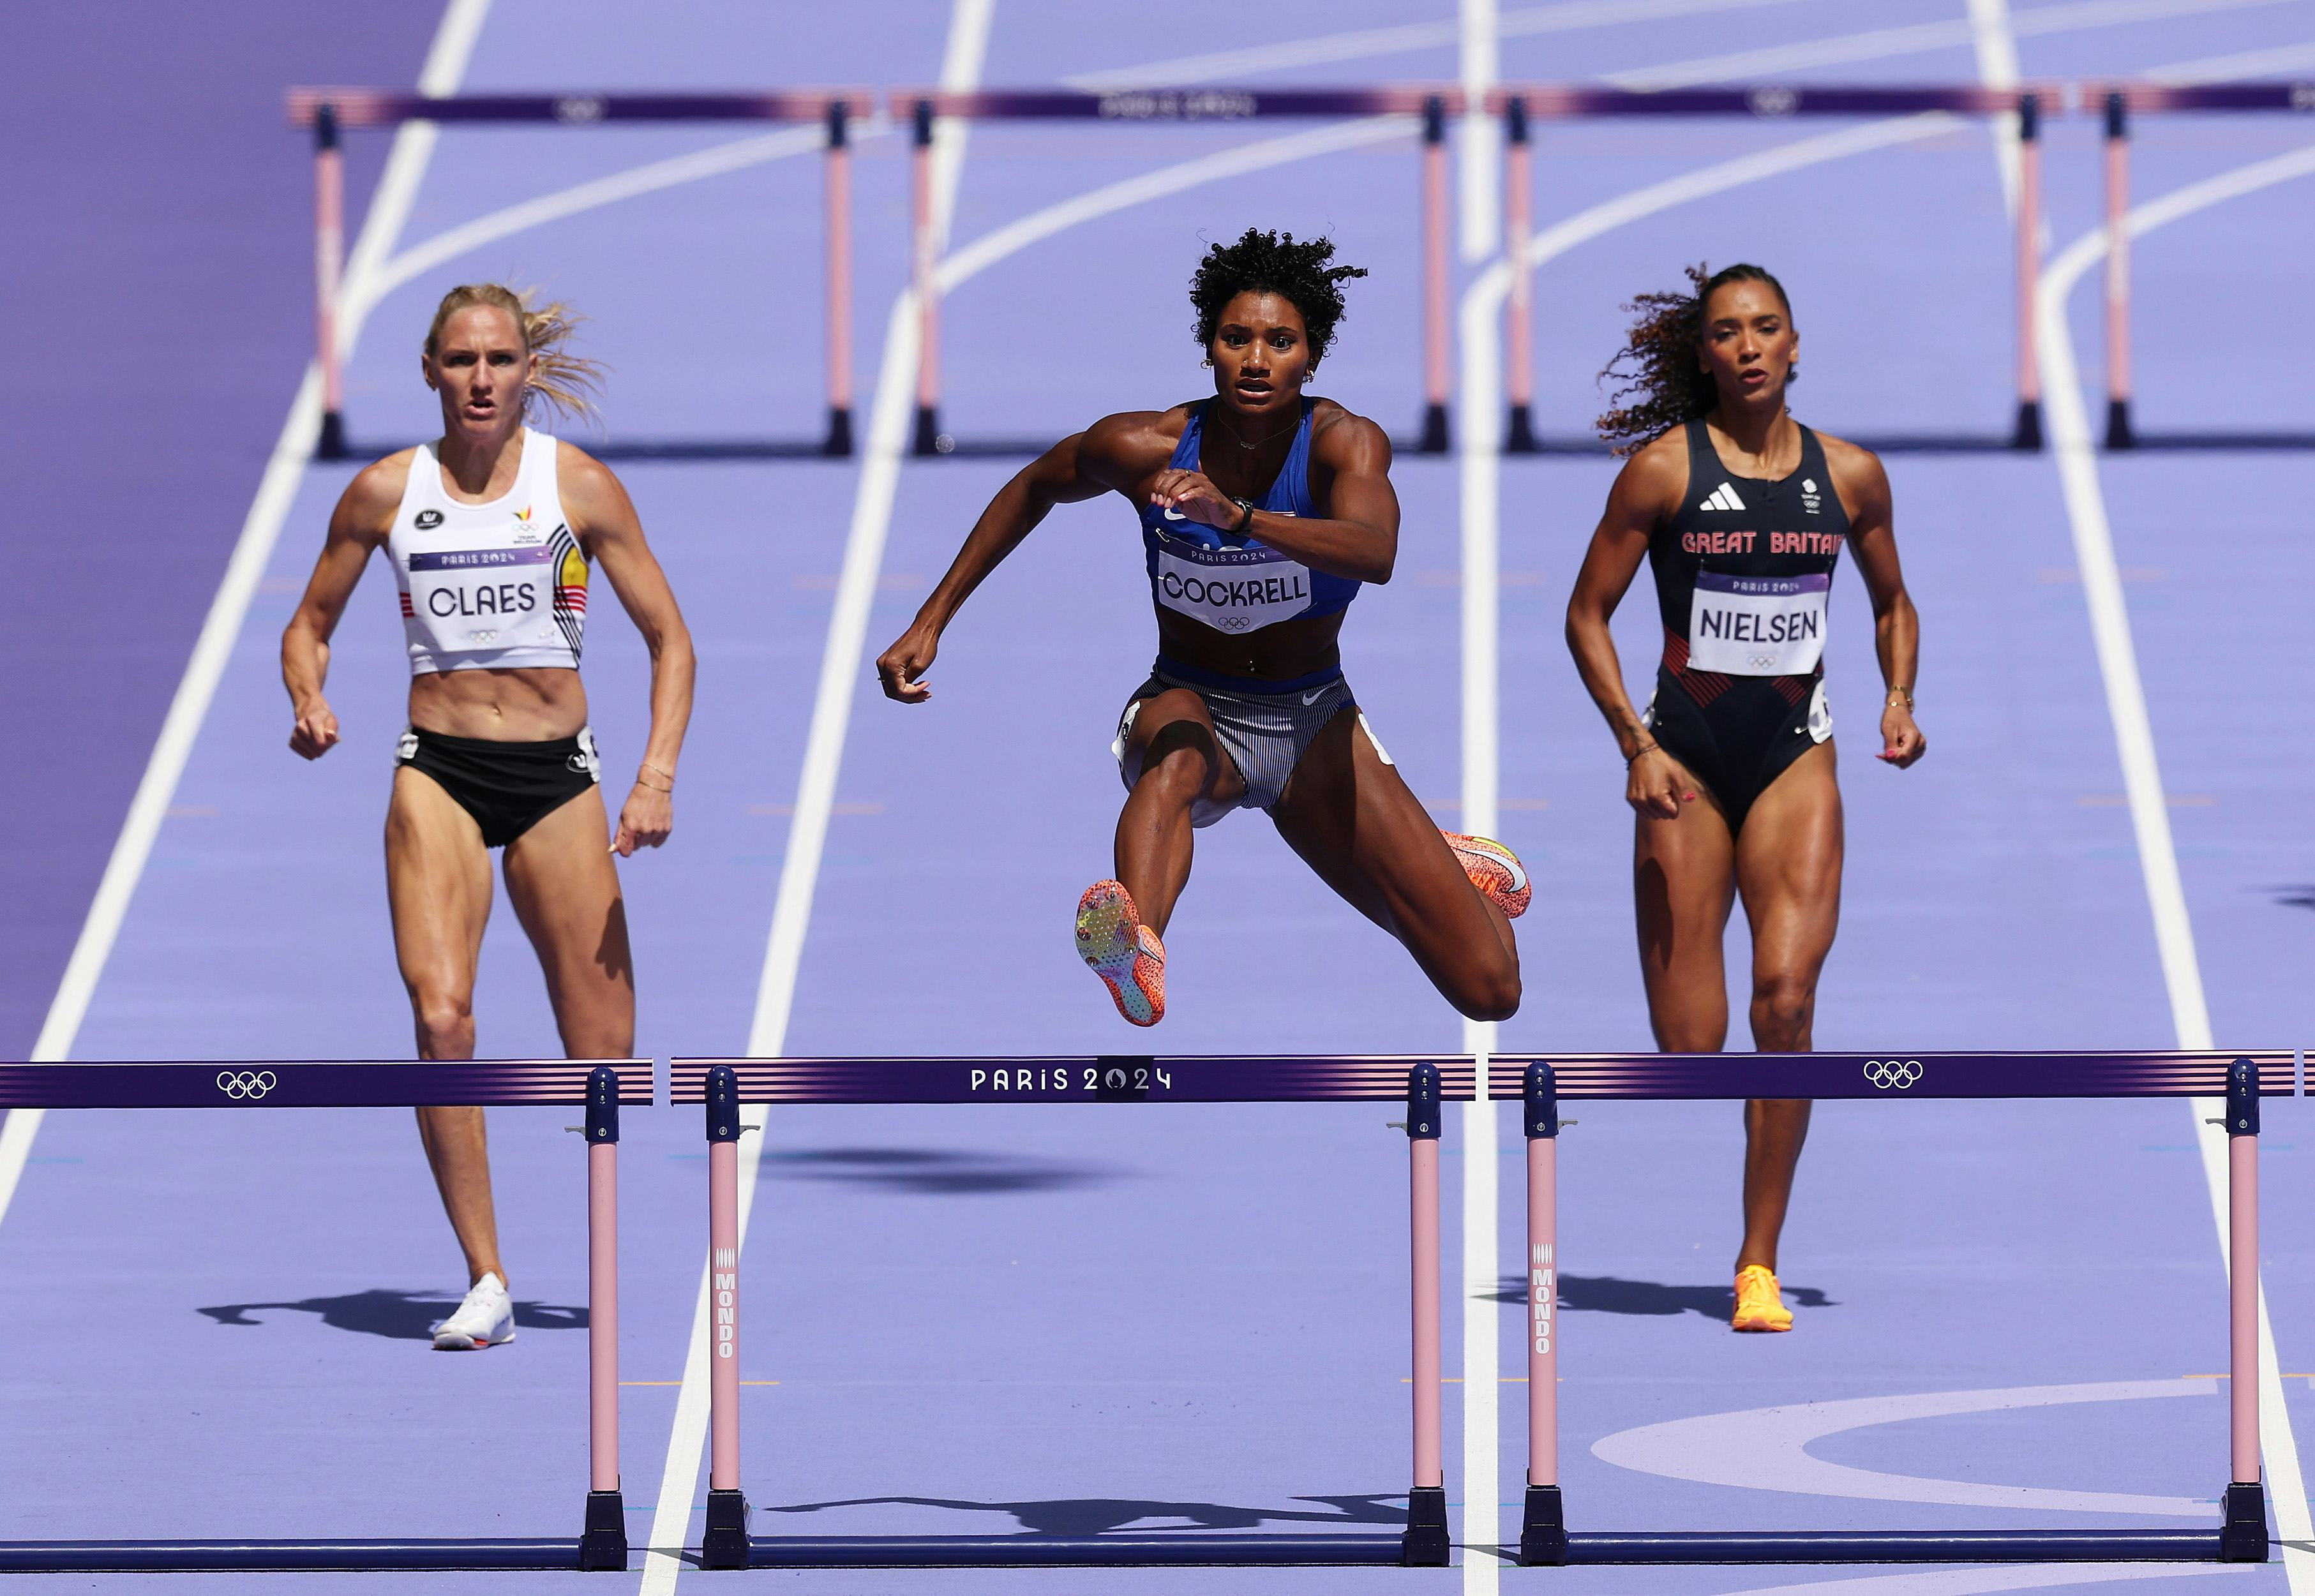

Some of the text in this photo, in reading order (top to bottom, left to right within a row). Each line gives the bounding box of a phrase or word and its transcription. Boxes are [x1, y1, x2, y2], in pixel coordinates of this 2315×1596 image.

[1192, 551, 1266, 562] PARIS 2024
[1681, 531, 1757, 554] GREAT
[441, 552, 516, 565] PARIS 2024
[429, 583, 536, 617] CLAES
[1163, 571, 1307, 607] COCKRELL
[1733, 581, 1769, 592] PARIS
[1700, 609, 1817, 643] NIELSEN
[1084, 1068, 1171, 1090] 2024
[715, 1273, 735, 1359] MONDO
[1532, 1269, 1552, 1354] MONDO
